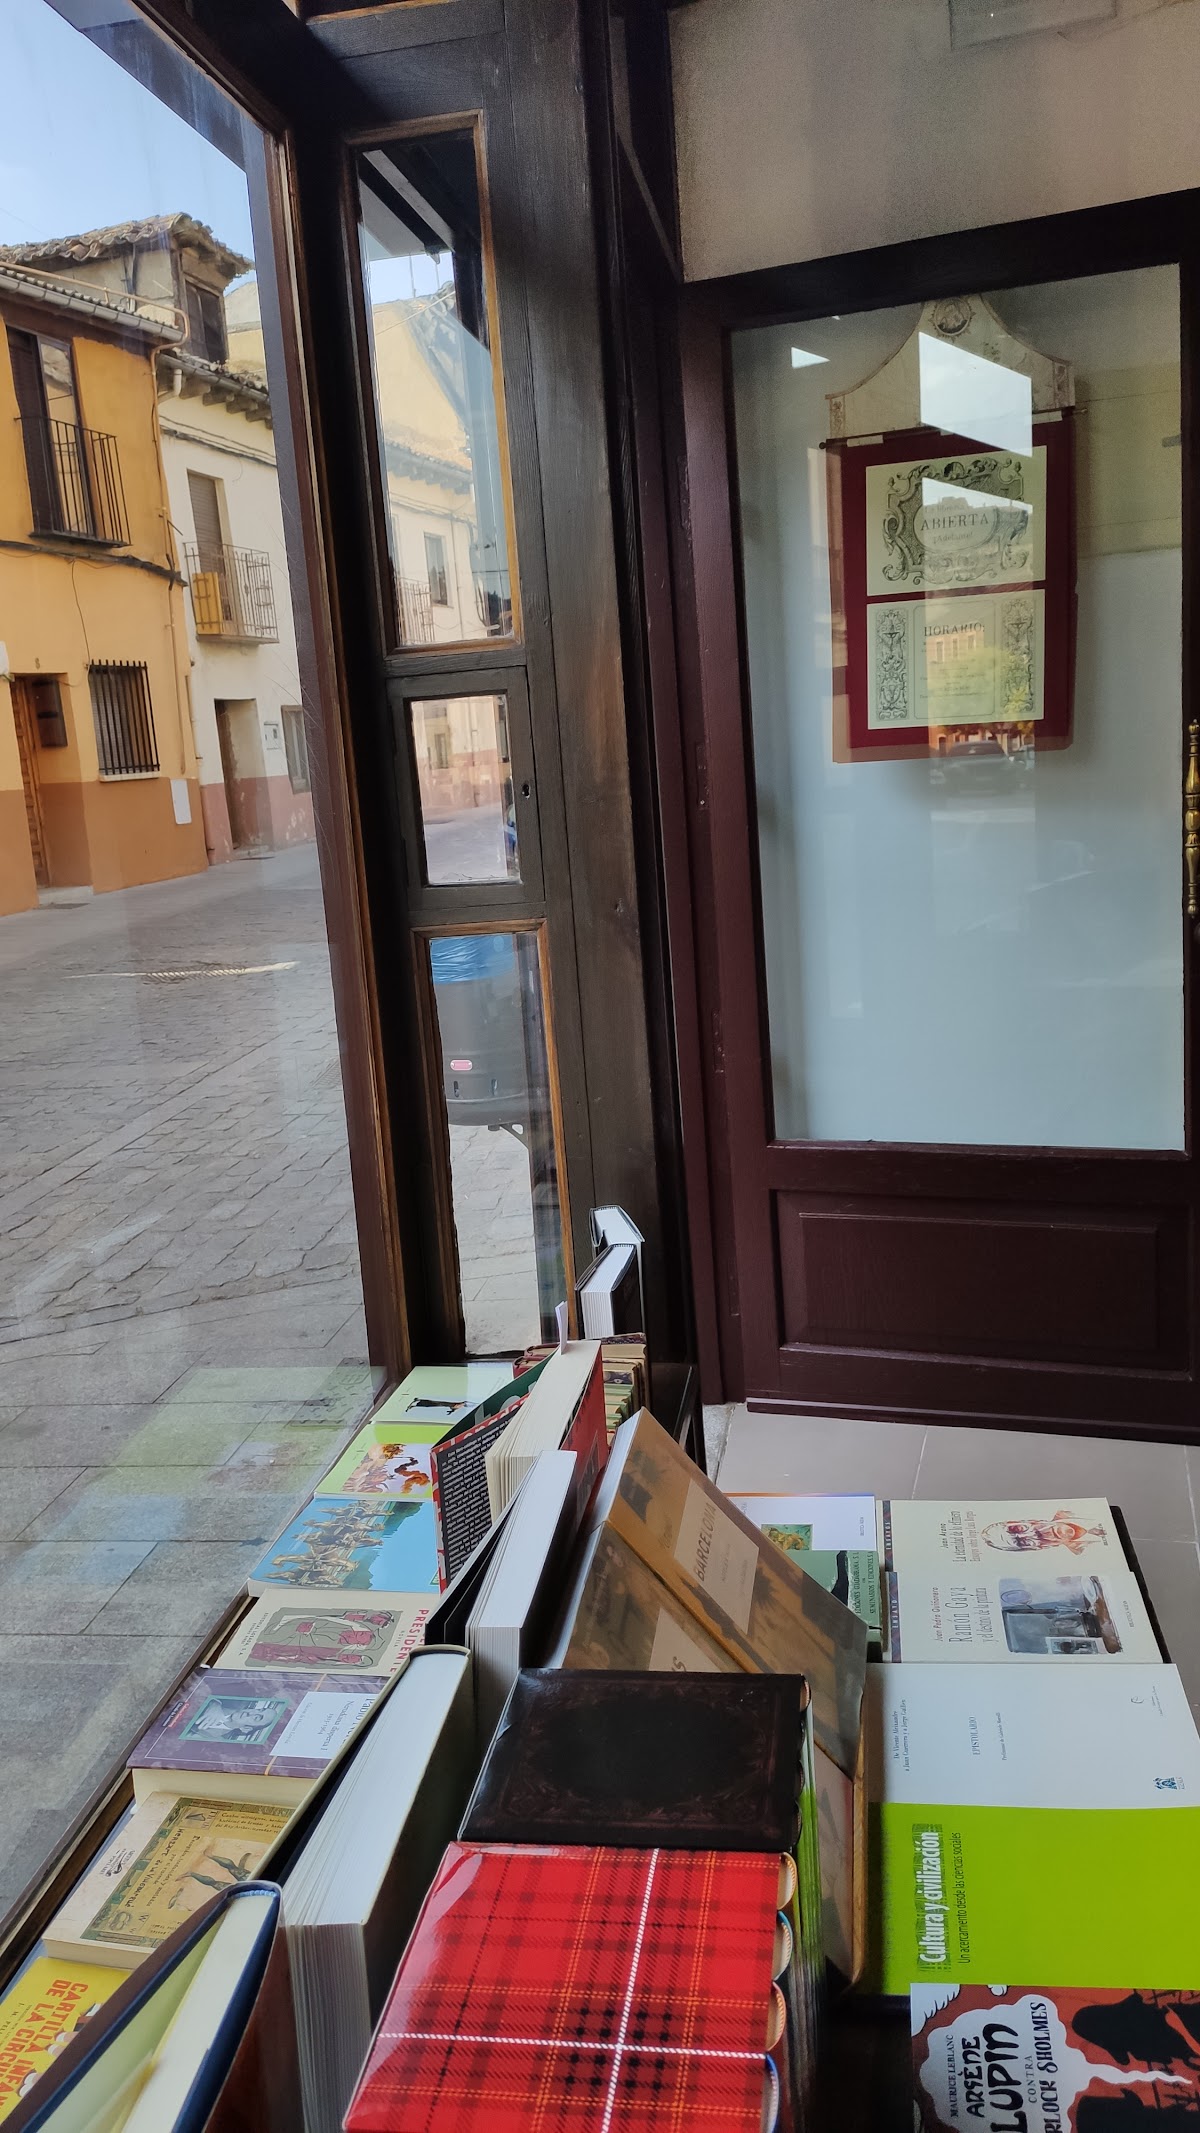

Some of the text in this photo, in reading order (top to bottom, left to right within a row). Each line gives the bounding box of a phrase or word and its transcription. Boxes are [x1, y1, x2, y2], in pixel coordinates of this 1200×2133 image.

[920, 513, 989, 531] ABIERTA
[923, 621, 986, 637] HORARIO:
[694, 1502, 718, 1582] BARCELONA
[944, 1587, 976, 1643] Ramón Gaya
[968, 1716, 980, 1755] EPISTOLARIO
[914, 1832, 950, 1963] Cultura y civilización
[949, 1832, 971, 1964] Un acercamiento desde las ciencias sociales
[25, 2002, 56, 2023] LA
[25, 1982, 89, 2053] CARTILLA
[46, 1979, 72, 1998] DE
[1029, 2002, 1058, 2074] SHOLMES
[945, 2034, 959, 2118] MAURICE LEBLANC
[957, 2035, 985, 2118] ARSÈNE
[982, 2023, 1028, 2133] LUPIN
[1024, 2055, 1037, 2104] CONTRA
